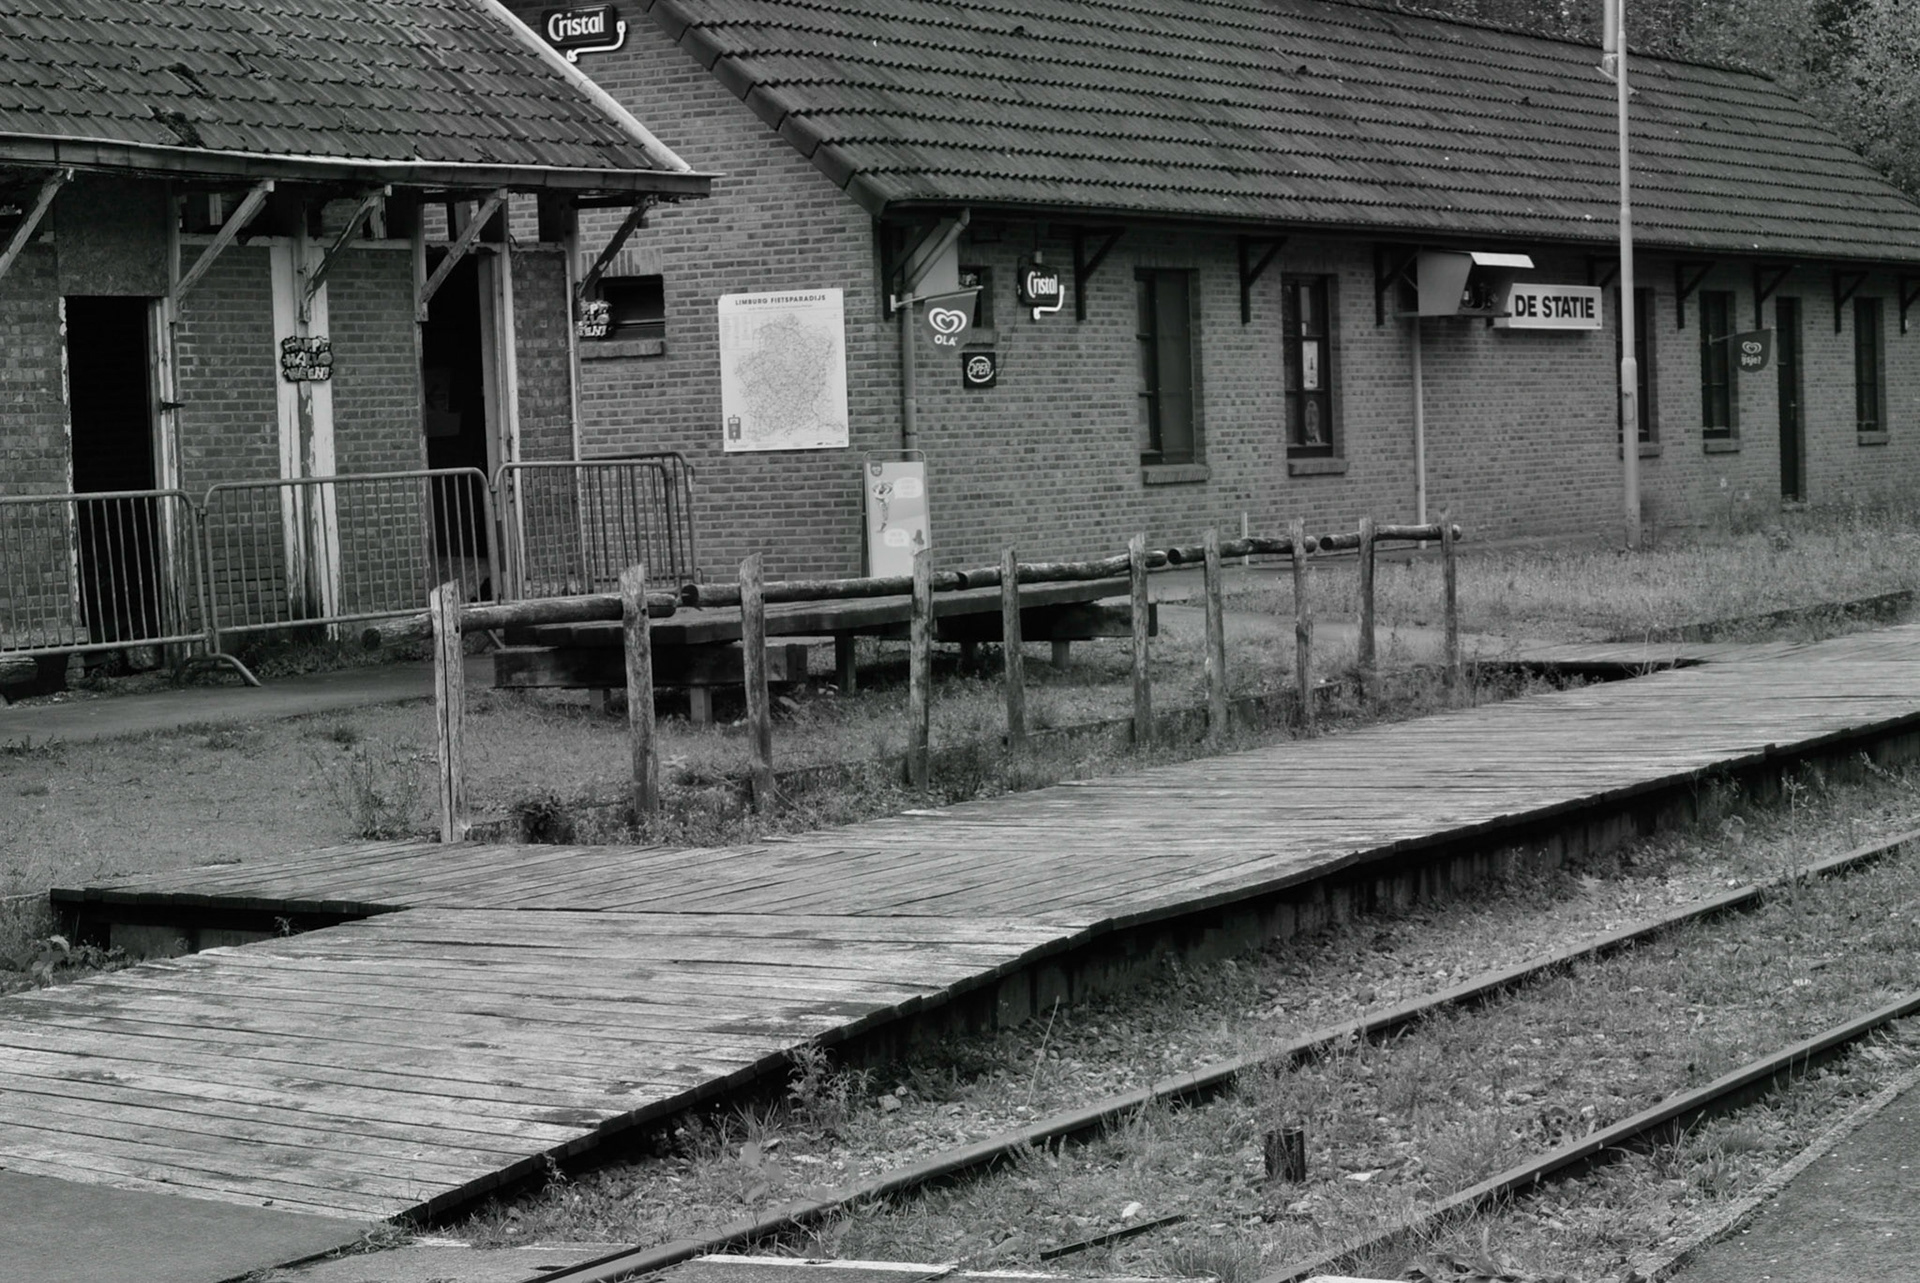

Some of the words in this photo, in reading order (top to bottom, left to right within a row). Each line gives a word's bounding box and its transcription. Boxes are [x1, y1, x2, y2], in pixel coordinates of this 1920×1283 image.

[548, 11, 604, 42] Cristal
[1027, 270, 1058, 298] Cristal
[735, 298, 768, 306] LIMBURG
[771, 295, 826, 304] FIETSPARADIJS
[1515, 294, 1537, 317] DE
[1542, 295, 1595, 318] STATIE
[934, 334, 956, 346] OLA
[967, 362, 991, 375] OPEN
